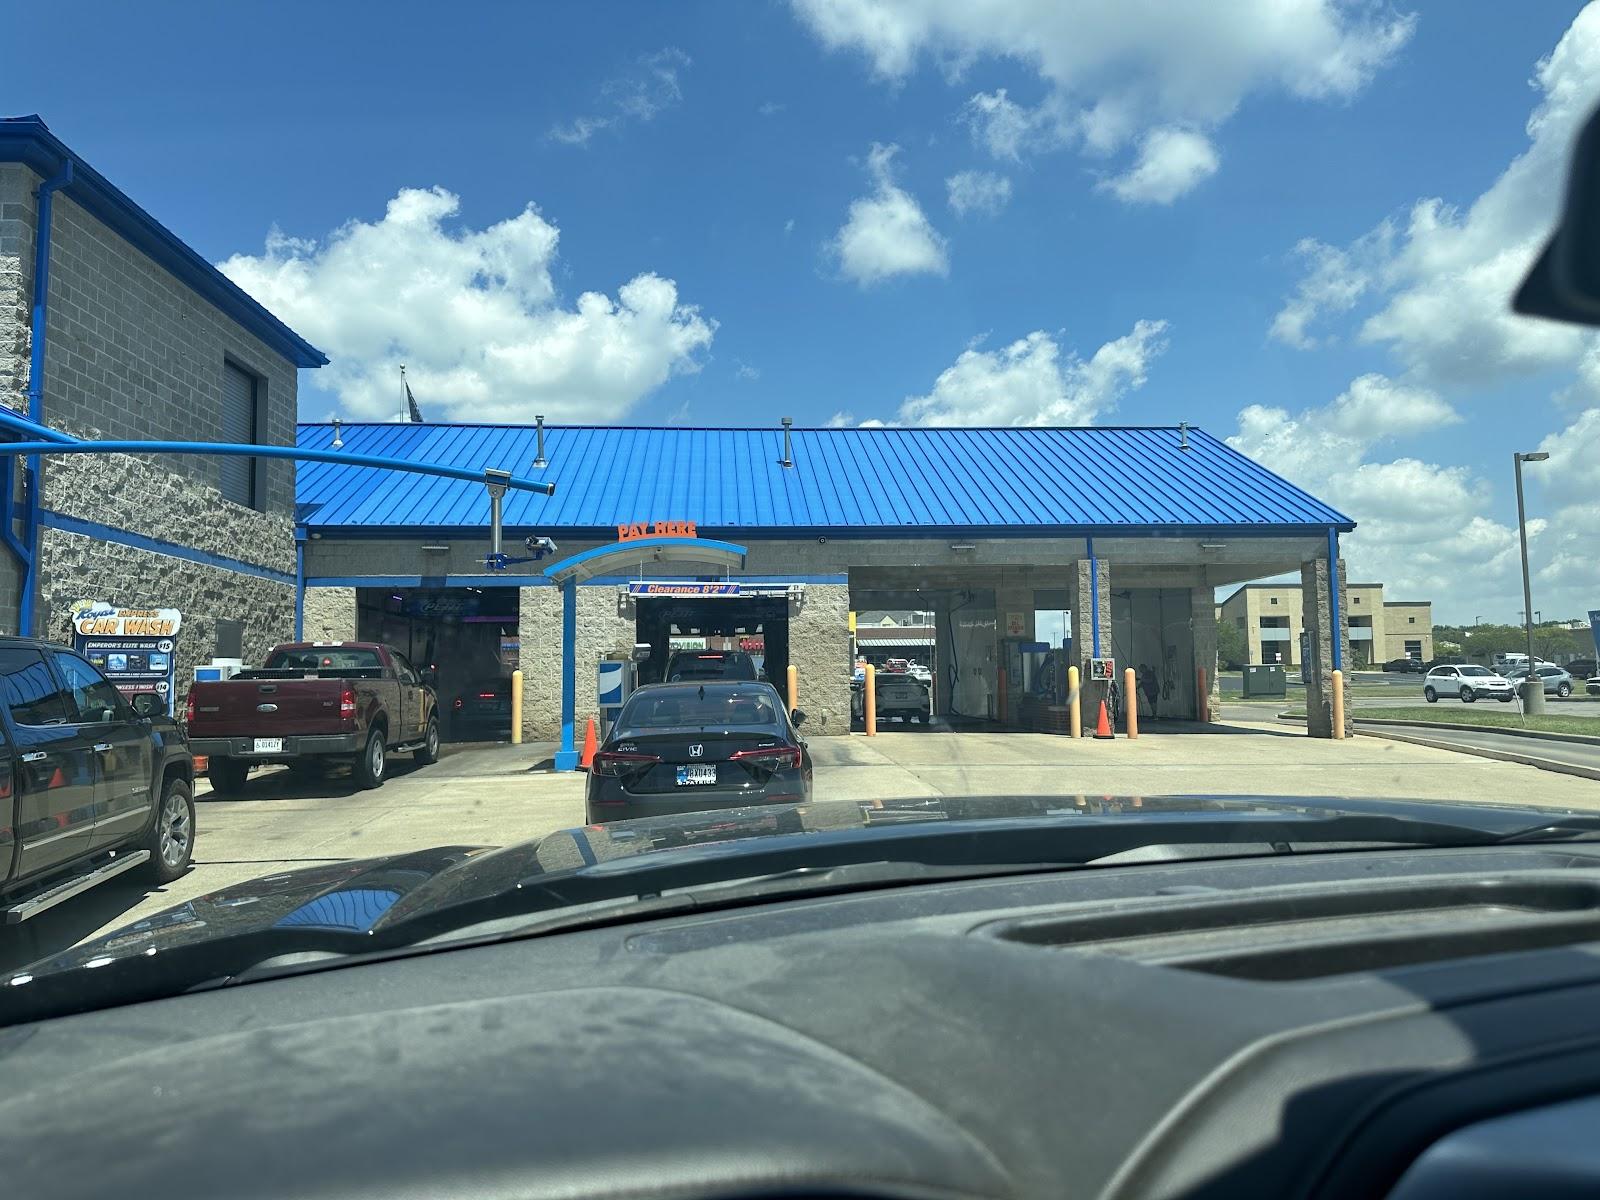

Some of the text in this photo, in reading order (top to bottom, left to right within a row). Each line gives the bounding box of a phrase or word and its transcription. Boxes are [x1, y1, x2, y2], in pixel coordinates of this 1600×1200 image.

[618, 521, 697, 541] PAY HERE
[647, 584, 725, 594] Clearance 8'2"
[76, 608, 115, 620] Royal
[80, 618, 174, 635] CAR WASH
